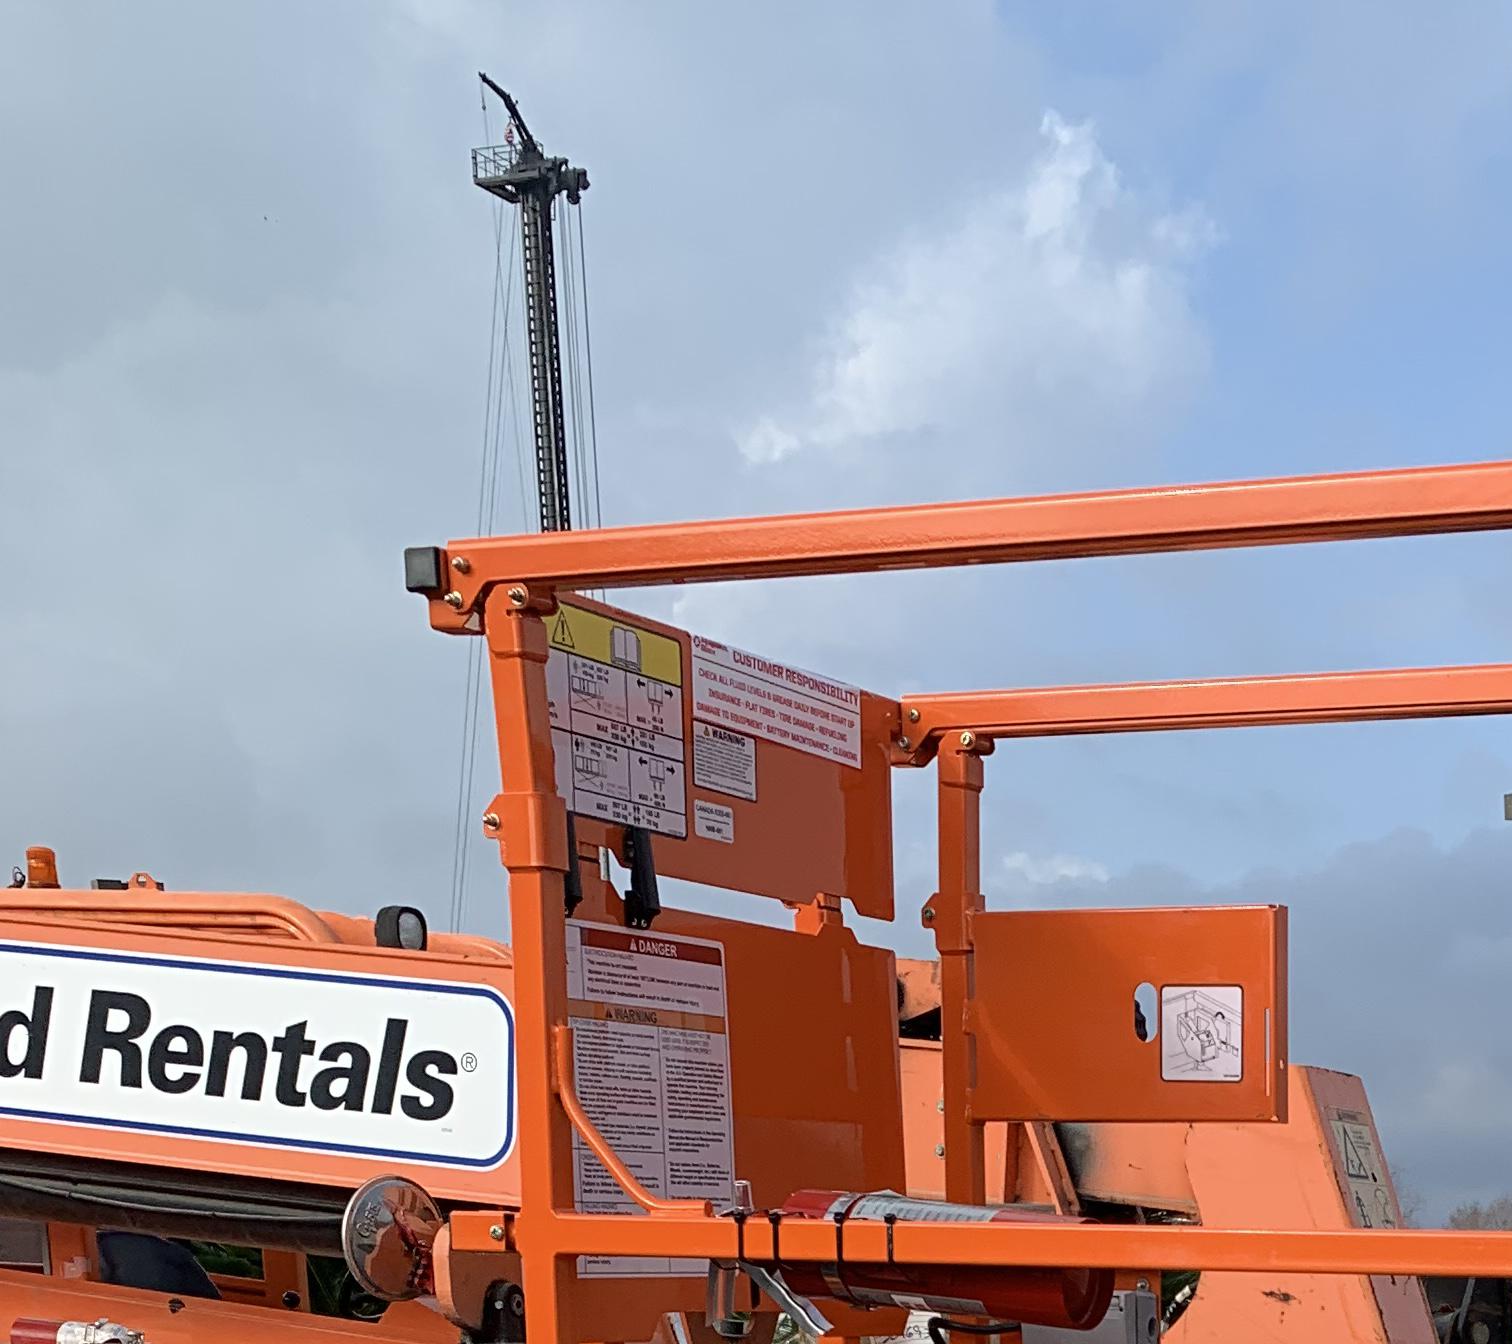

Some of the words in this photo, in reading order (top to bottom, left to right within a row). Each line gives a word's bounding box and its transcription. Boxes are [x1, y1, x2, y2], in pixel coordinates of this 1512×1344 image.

[733, 650, 784, 679] CUSTOMER
[785, 668, 858, 707] RESPONSIBILITY
[712, 728, 746, 747] WARNING
[638, 940, 678, 958] DANGER
[614, 1008, 658, 1024] WARNING
[79, 989, 458, 1121] Rentals
